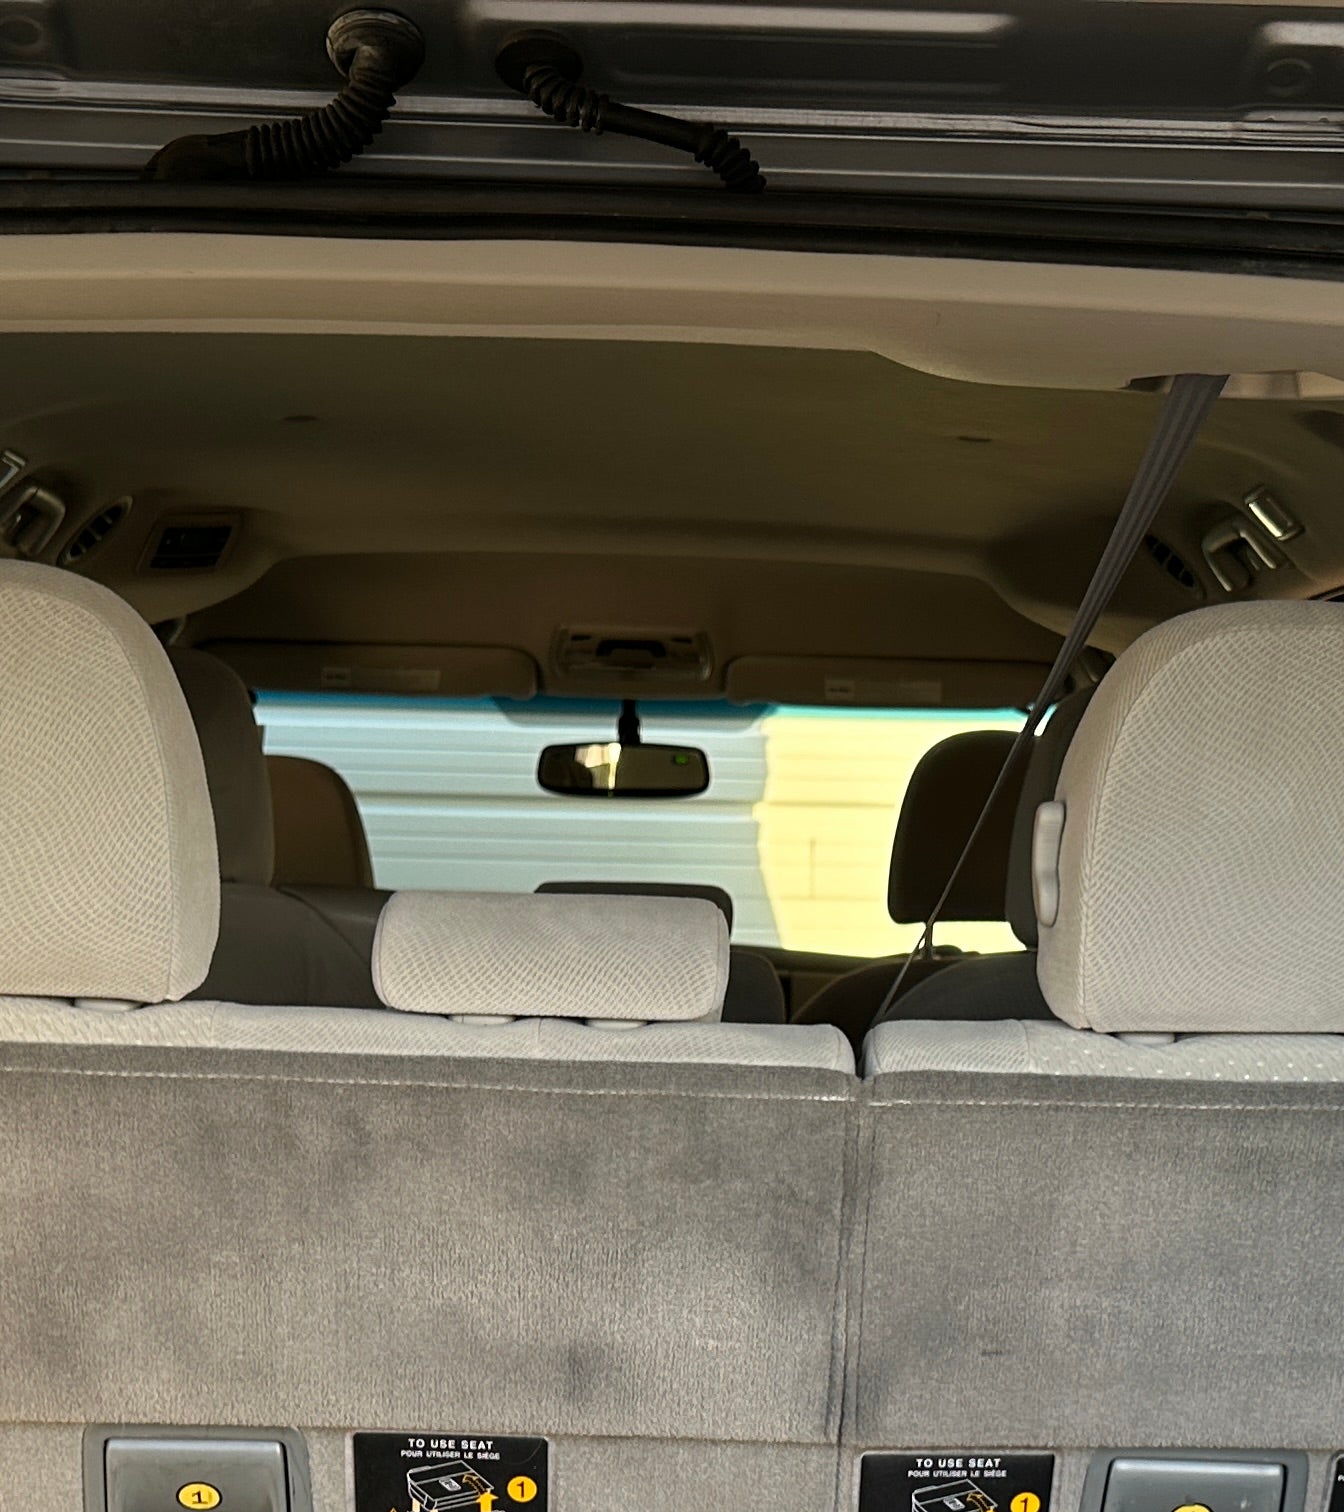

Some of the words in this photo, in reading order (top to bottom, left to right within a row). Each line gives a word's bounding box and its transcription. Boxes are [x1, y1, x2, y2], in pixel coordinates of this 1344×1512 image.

[408, 1438, 425, 1448] TO
[430, 1439, 455, 1449] USE
[461, 1440, 493, 1450] SEAT
[401, 1450, 423, 1458] POUR
[916, 1458, 933, 1467] TO
[938, 1458, 963, 1468] USE
[969, 1459, 1001, 1468] SEAT
[516, 1481, 525, 1498] 1
[191, 1489, 208, 1505] 1
